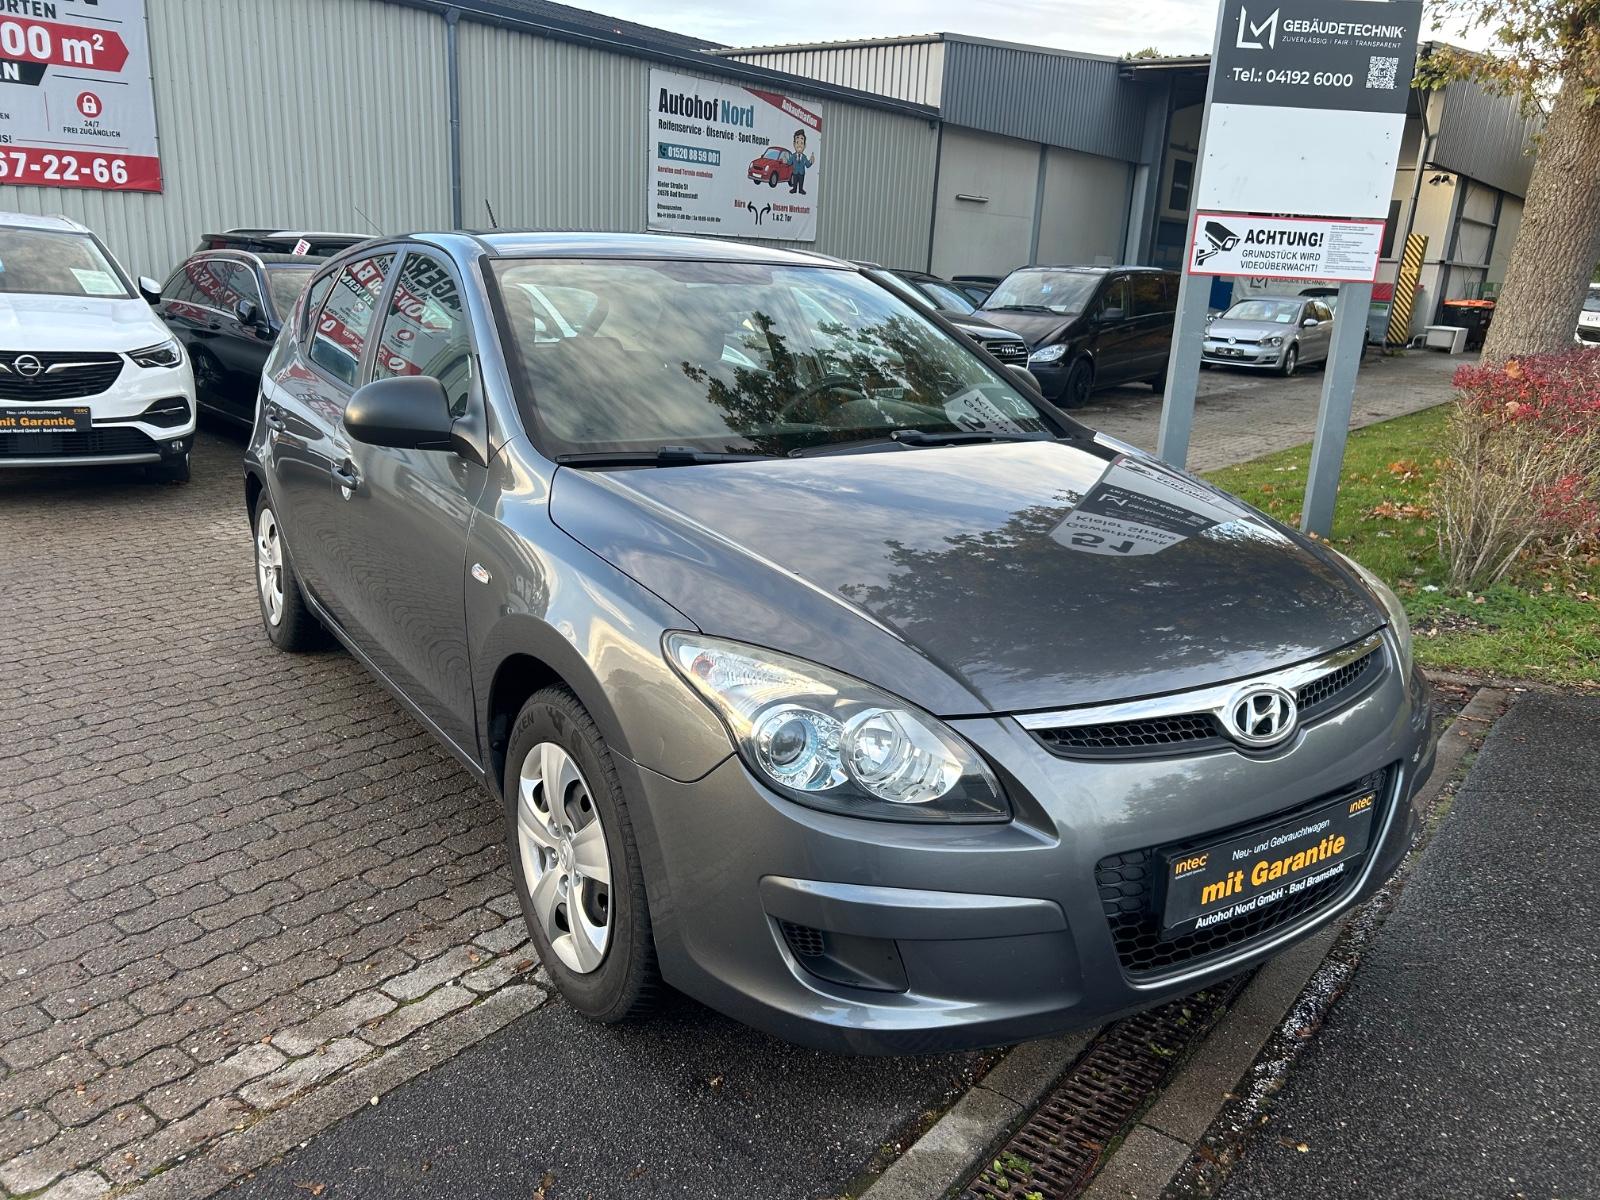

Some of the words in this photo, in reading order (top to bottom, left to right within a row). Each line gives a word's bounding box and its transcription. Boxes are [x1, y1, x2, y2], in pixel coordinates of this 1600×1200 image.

[1283, 18, 1404, 39] GEBÄUDETECHNIK
[1334, 38, 1349, 46] FAIR
[1355, 40, 1402, 49] TRANSPARENT
[0, 62, 20, 81] N
[1265, 69, 1310, 86] 04192
[1313, 71, 1354, 88] 6000
[658, 87, 719, 122] Autohof
[721, 99, 755, 129] Nord
[63, 126, 78, 134] FREI
[658, 118, 702, 136] Reifenservice
[738, 133, 752, 144] Spot
[752, 134, 770, 147] Repair
[668, 146, 688, 159] 01520
[698, 150, 708, 162] 59
[1244, 228, 1324, 248] ACHTUNG!
[1241, 249, 1298, 261] GRUNDSTÜCK
[1299, 253, 1321, 262] WIRD
[1240, 259, 1318, 273] VIDEOÜBERWACHT!
[20, 416, 75, 426] Garantie
[1349, 795, 1374, 813] intec
[1232, 848, 1252, 861] Neu-
[1253, 839, 1270, 854] und
[1174, 854, 1208, 875] intec
[1200, 870, 1244, 905] mit
[1250, 833, 1346, 887] Garantie
[1195, 908, 1233, 929] Autohof
[1234, 899, 1257, 918] Nord
[1257, 888, 1284, 907] GmbH
[1288, 880, 1306, 895] Bad
[1305, 862, 1345, 887] Bramstedt
